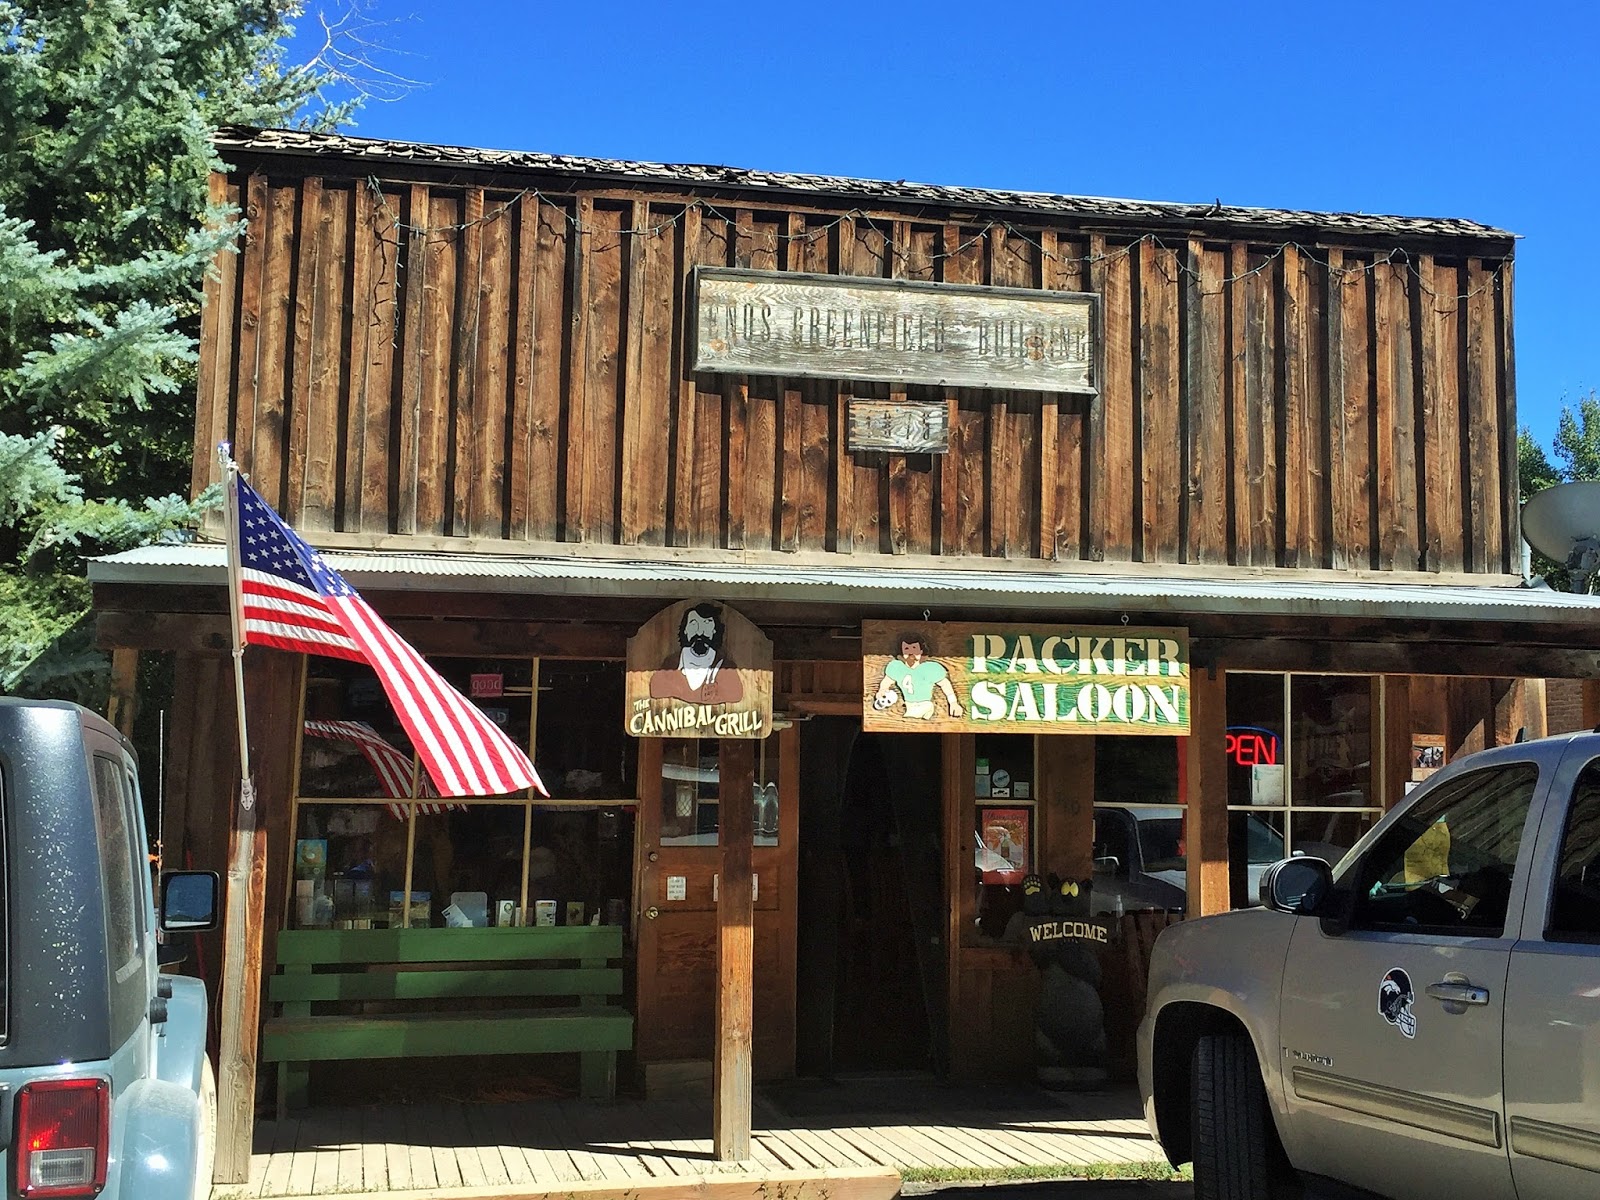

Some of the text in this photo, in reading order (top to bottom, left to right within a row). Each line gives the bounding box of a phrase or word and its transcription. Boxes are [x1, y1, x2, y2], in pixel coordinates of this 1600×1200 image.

[708, 302, 772, 344] ENOS
[971, 634, 1181, 677] PACKER
[902, 674, 914, 695] 4
[633, 698, 650, 712] THE
[970, 681, 1180, 724] SALOON
[629, 704, 763, 736] CANNIBAL GRILL
[1225, 734, 1276, 766] PEN
[1029, 921, 1109, 944] WELCOME
